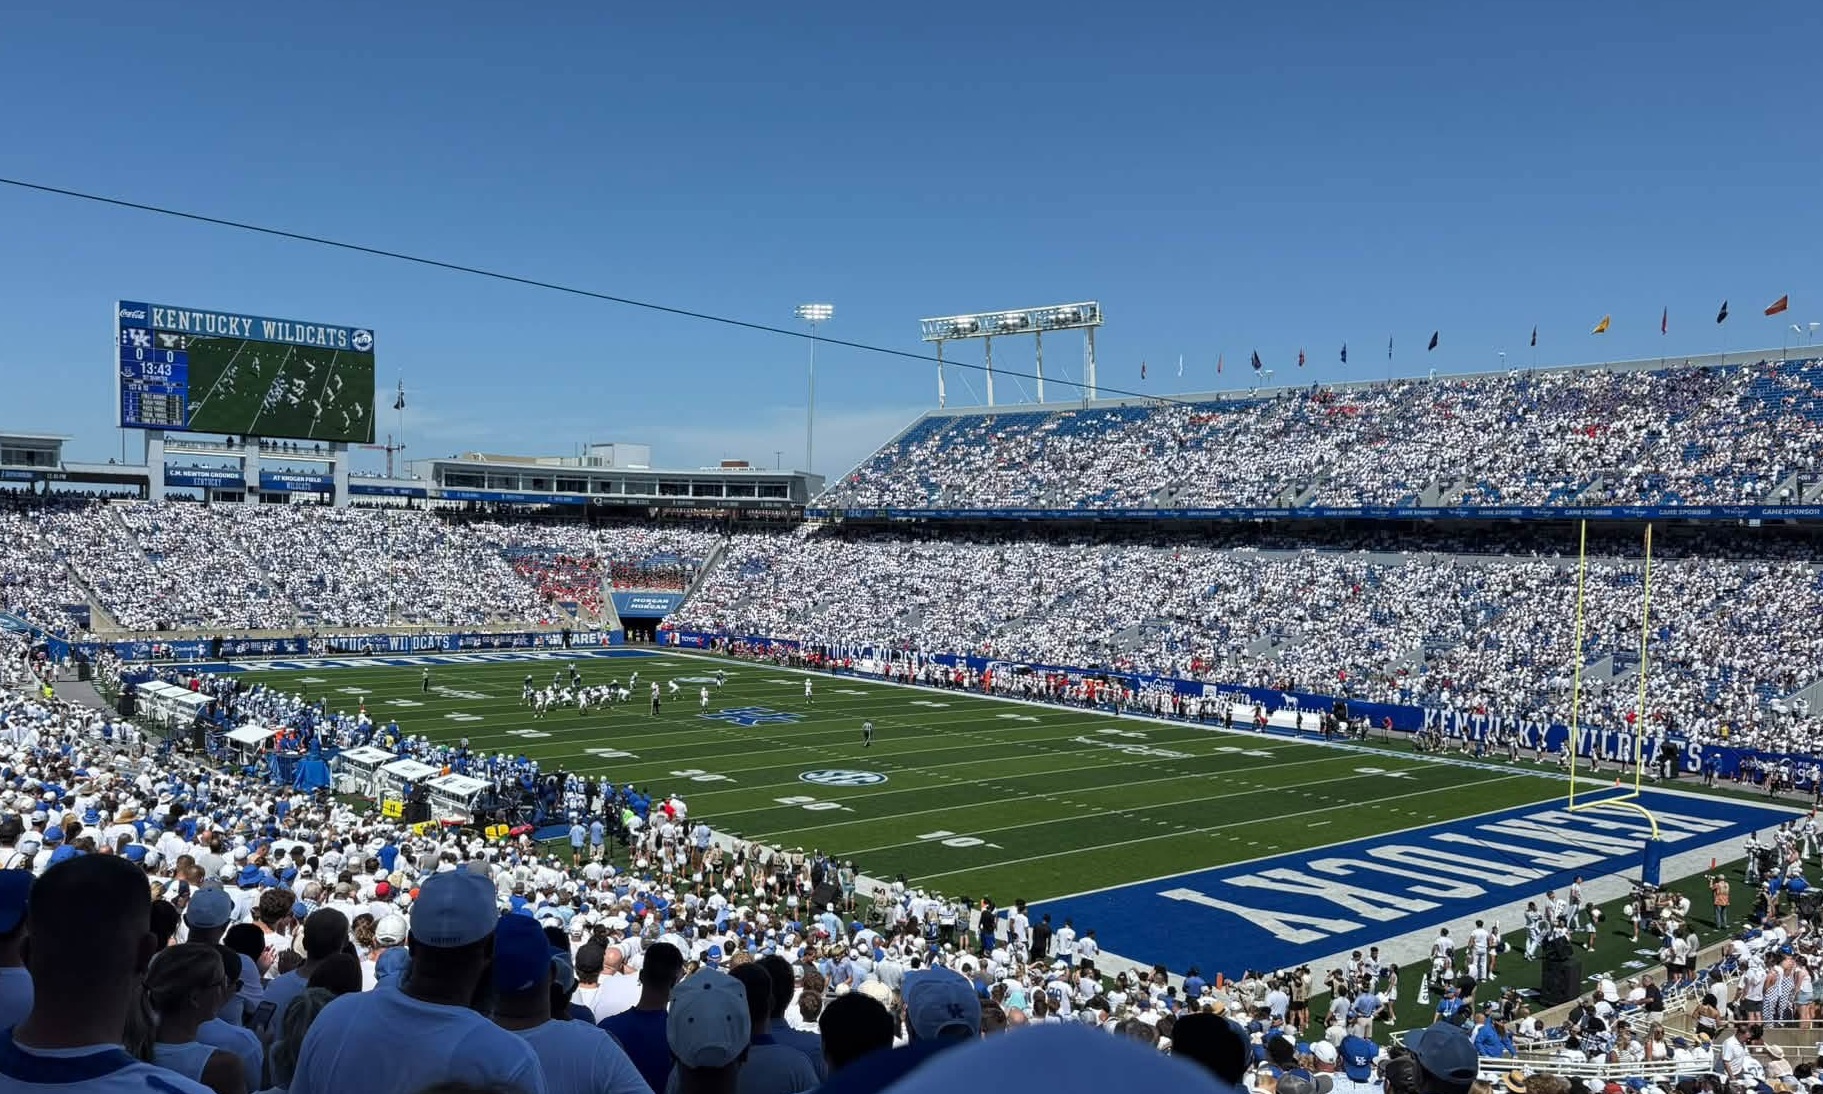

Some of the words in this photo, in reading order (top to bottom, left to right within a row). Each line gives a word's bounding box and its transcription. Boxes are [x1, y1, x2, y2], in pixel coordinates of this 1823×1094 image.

[152, 308, 252, 337] KENTUCKY
[262, 320, 347, 347] WILDCATS
[136, 347, 143, 360] 0
[166, 351, 174, 363] 0
[140, 361, 172, 376] 13:43
[193, 478, 222, 487] KENTUCKY
[286, 482, 312, 491] WILDCATS
[572, 633, 597, 645] ARE
[916, 830, 986, 848] 10
[1155, 805, 1739, 944] KENTUCKY
